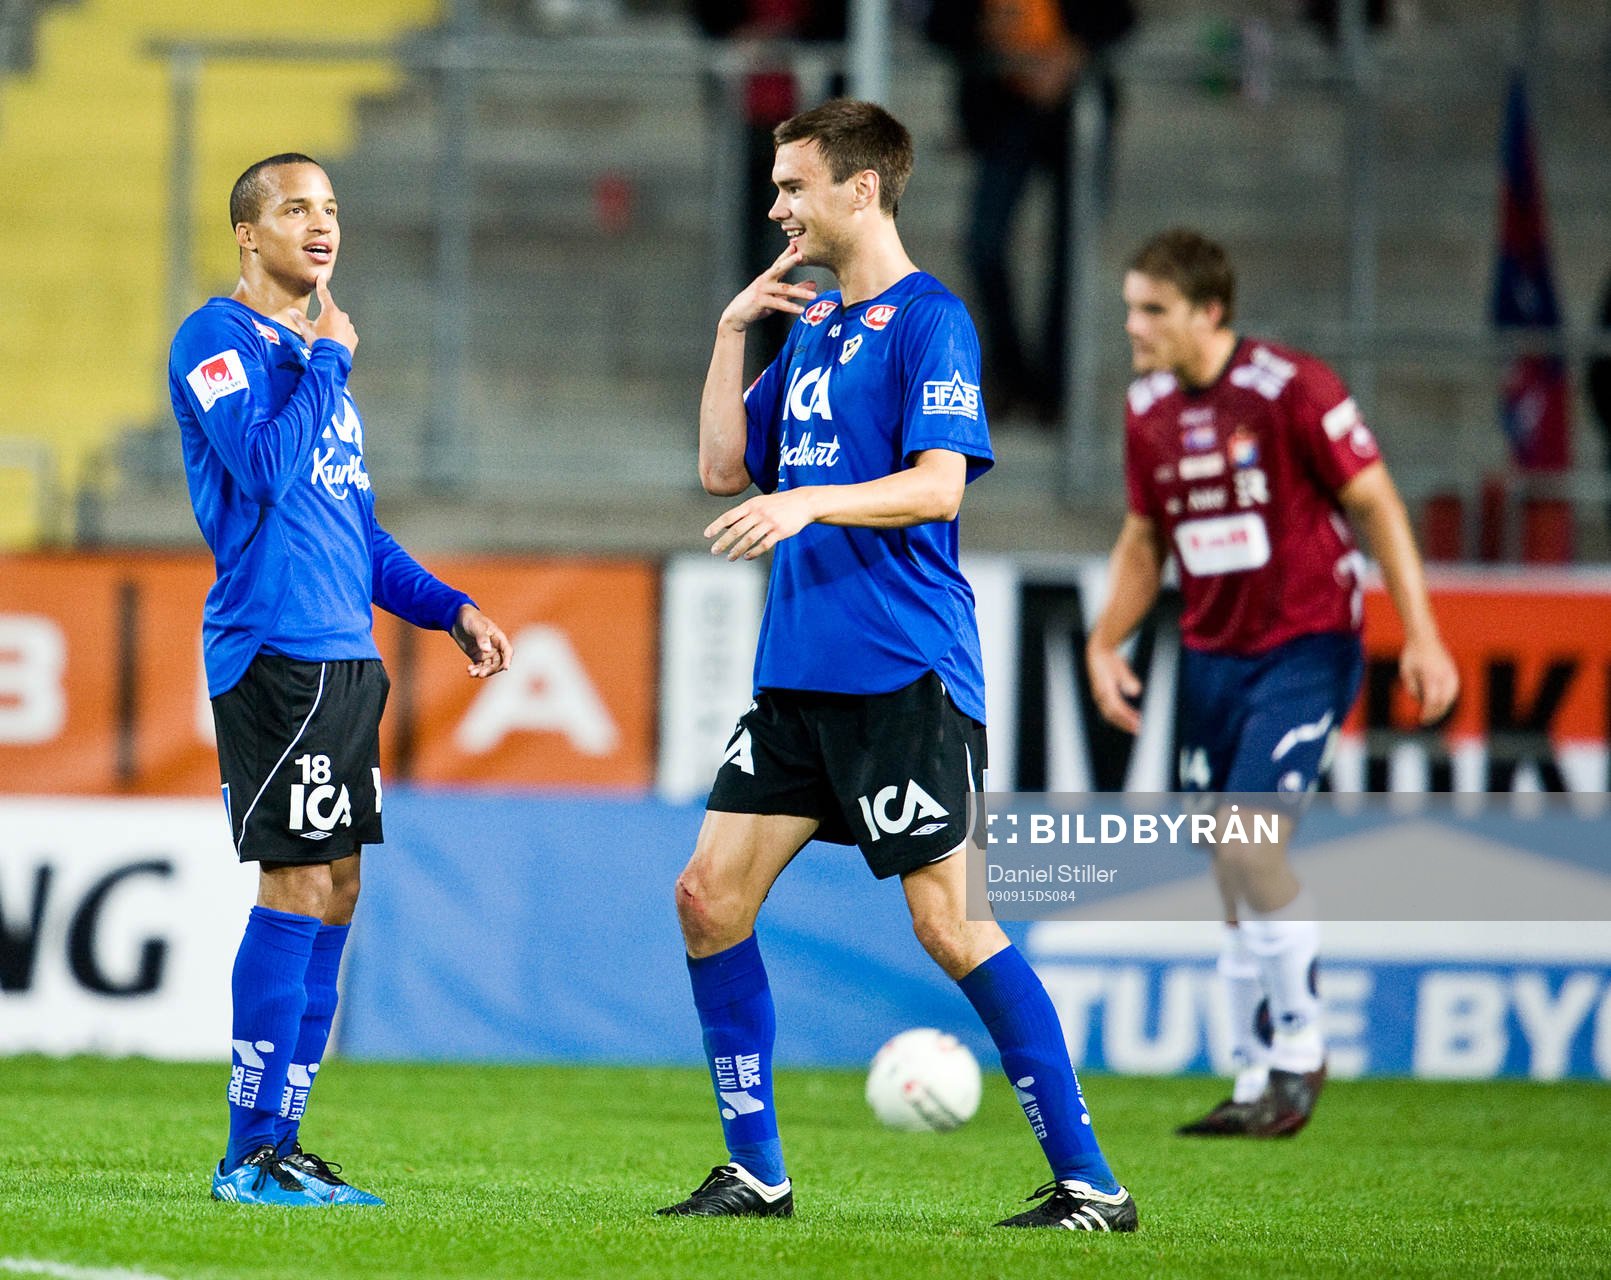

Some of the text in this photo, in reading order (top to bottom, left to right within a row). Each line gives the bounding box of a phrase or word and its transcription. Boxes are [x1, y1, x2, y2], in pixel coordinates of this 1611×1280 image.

[783, 366, 832, 421] ICA
[923, 384, 978, 410] HFAB
[295, 754, 331, 784] 18
[289, 783, 351, 831] ICA
[858, 778, 949, 842] ICA
[1415, 970, 1611, 1080] BY
[241, 1069, 263, 1110] INTER
[714, 1056, 738, 1090] INTER
[288, 1089, 309, 1121] INTER
[1024, 1103, 1048, 1141] INTER
